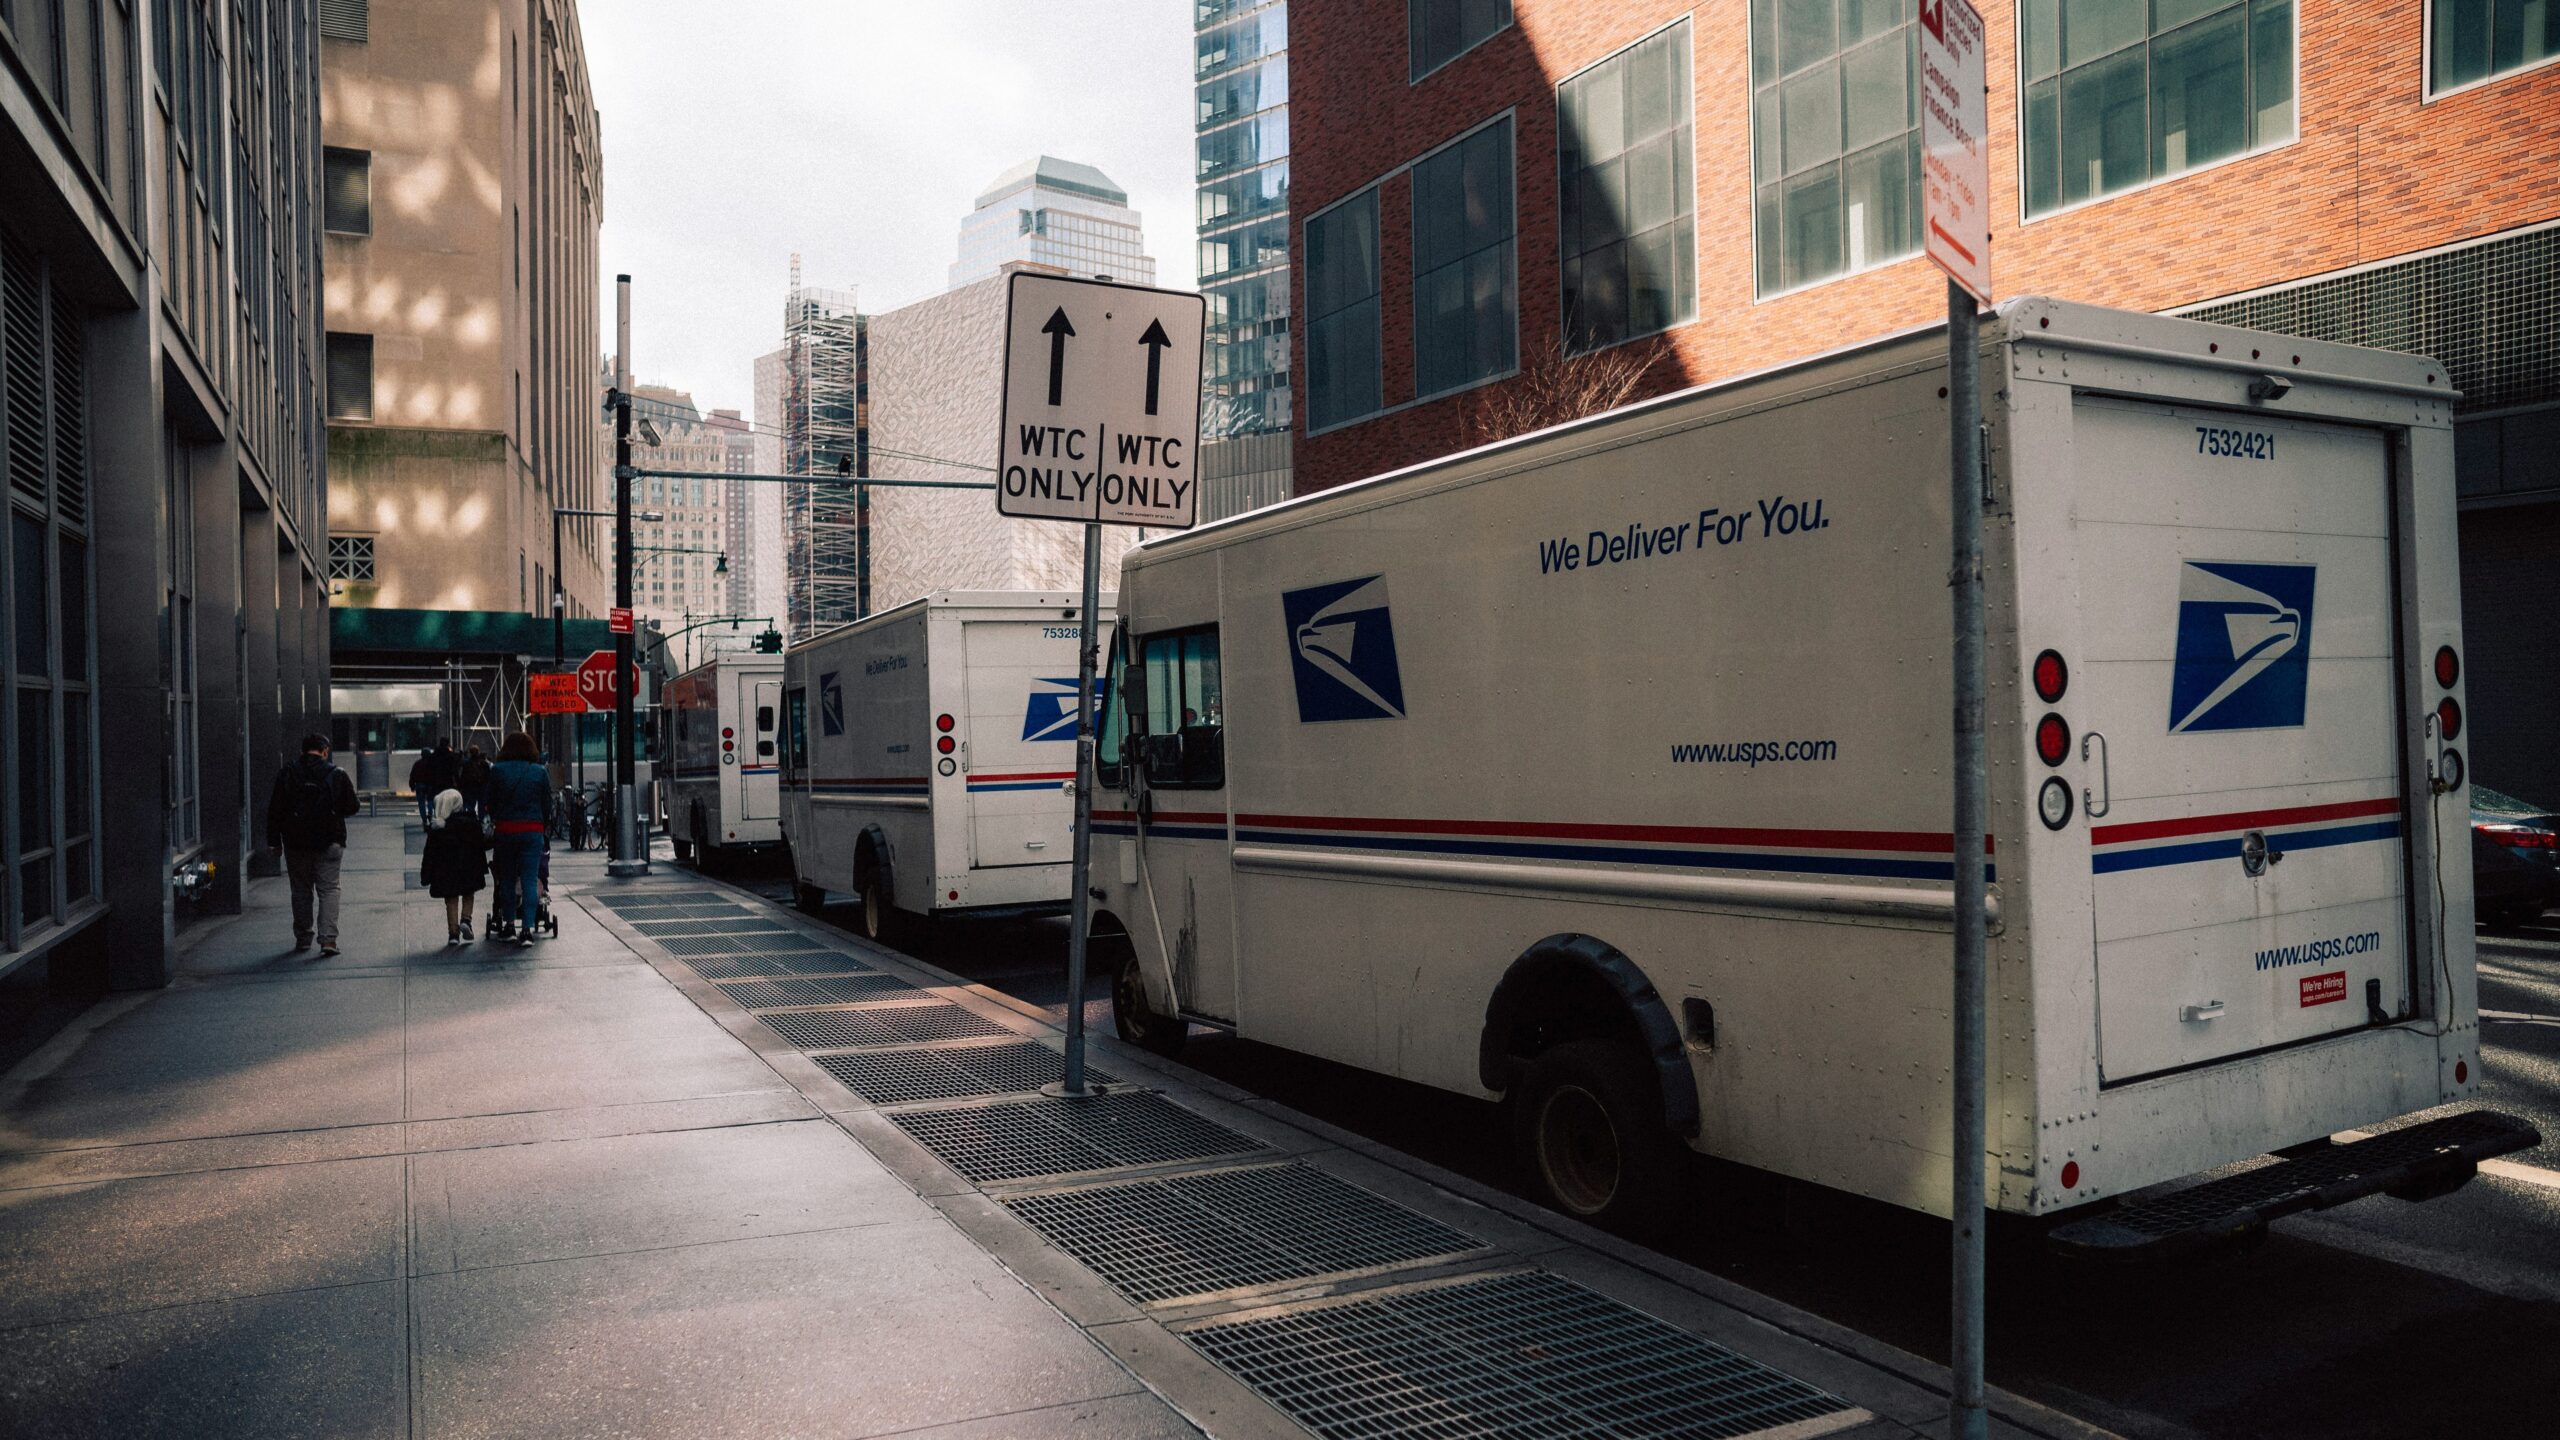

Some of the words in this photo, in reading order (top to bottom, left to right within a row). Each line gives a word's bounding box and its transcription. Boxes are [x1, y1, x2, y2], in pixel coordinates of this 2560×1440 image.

[1945, 6, 1972, 55] Vehicles
[1946, 32, 1960, 68] Only
[1923, 51, 1960, 109] Campaign
[1924, 84, 1953, 134] Finance
[1955, 117, 1976, 157] Board
[1020, 424, 1086, 460] WTC
[1117, 433, 1182, 468] WTC
[2196, 426, 2274, 460] 7532421
[1005, 465, 1095, 502] ONLY
[1103, 474, 1190, 510] ONLY
[1539, 537, 1579, 574] We
[1586, 522, 1690, 567] Deliver
[1696, 508, 1752, 549] For
[1758, 496, 1830, 537] You.
[582, 669, 636, 692] STO
[541, 700, 576, 708] CLOSED
[1671, 739, 1837, 768] www.usps.com
[2255, 931, 2380, 971] www.usps.com
[2303, 981, 2322, 992] We're
[2323, 977, 2343, 988] Hiring
